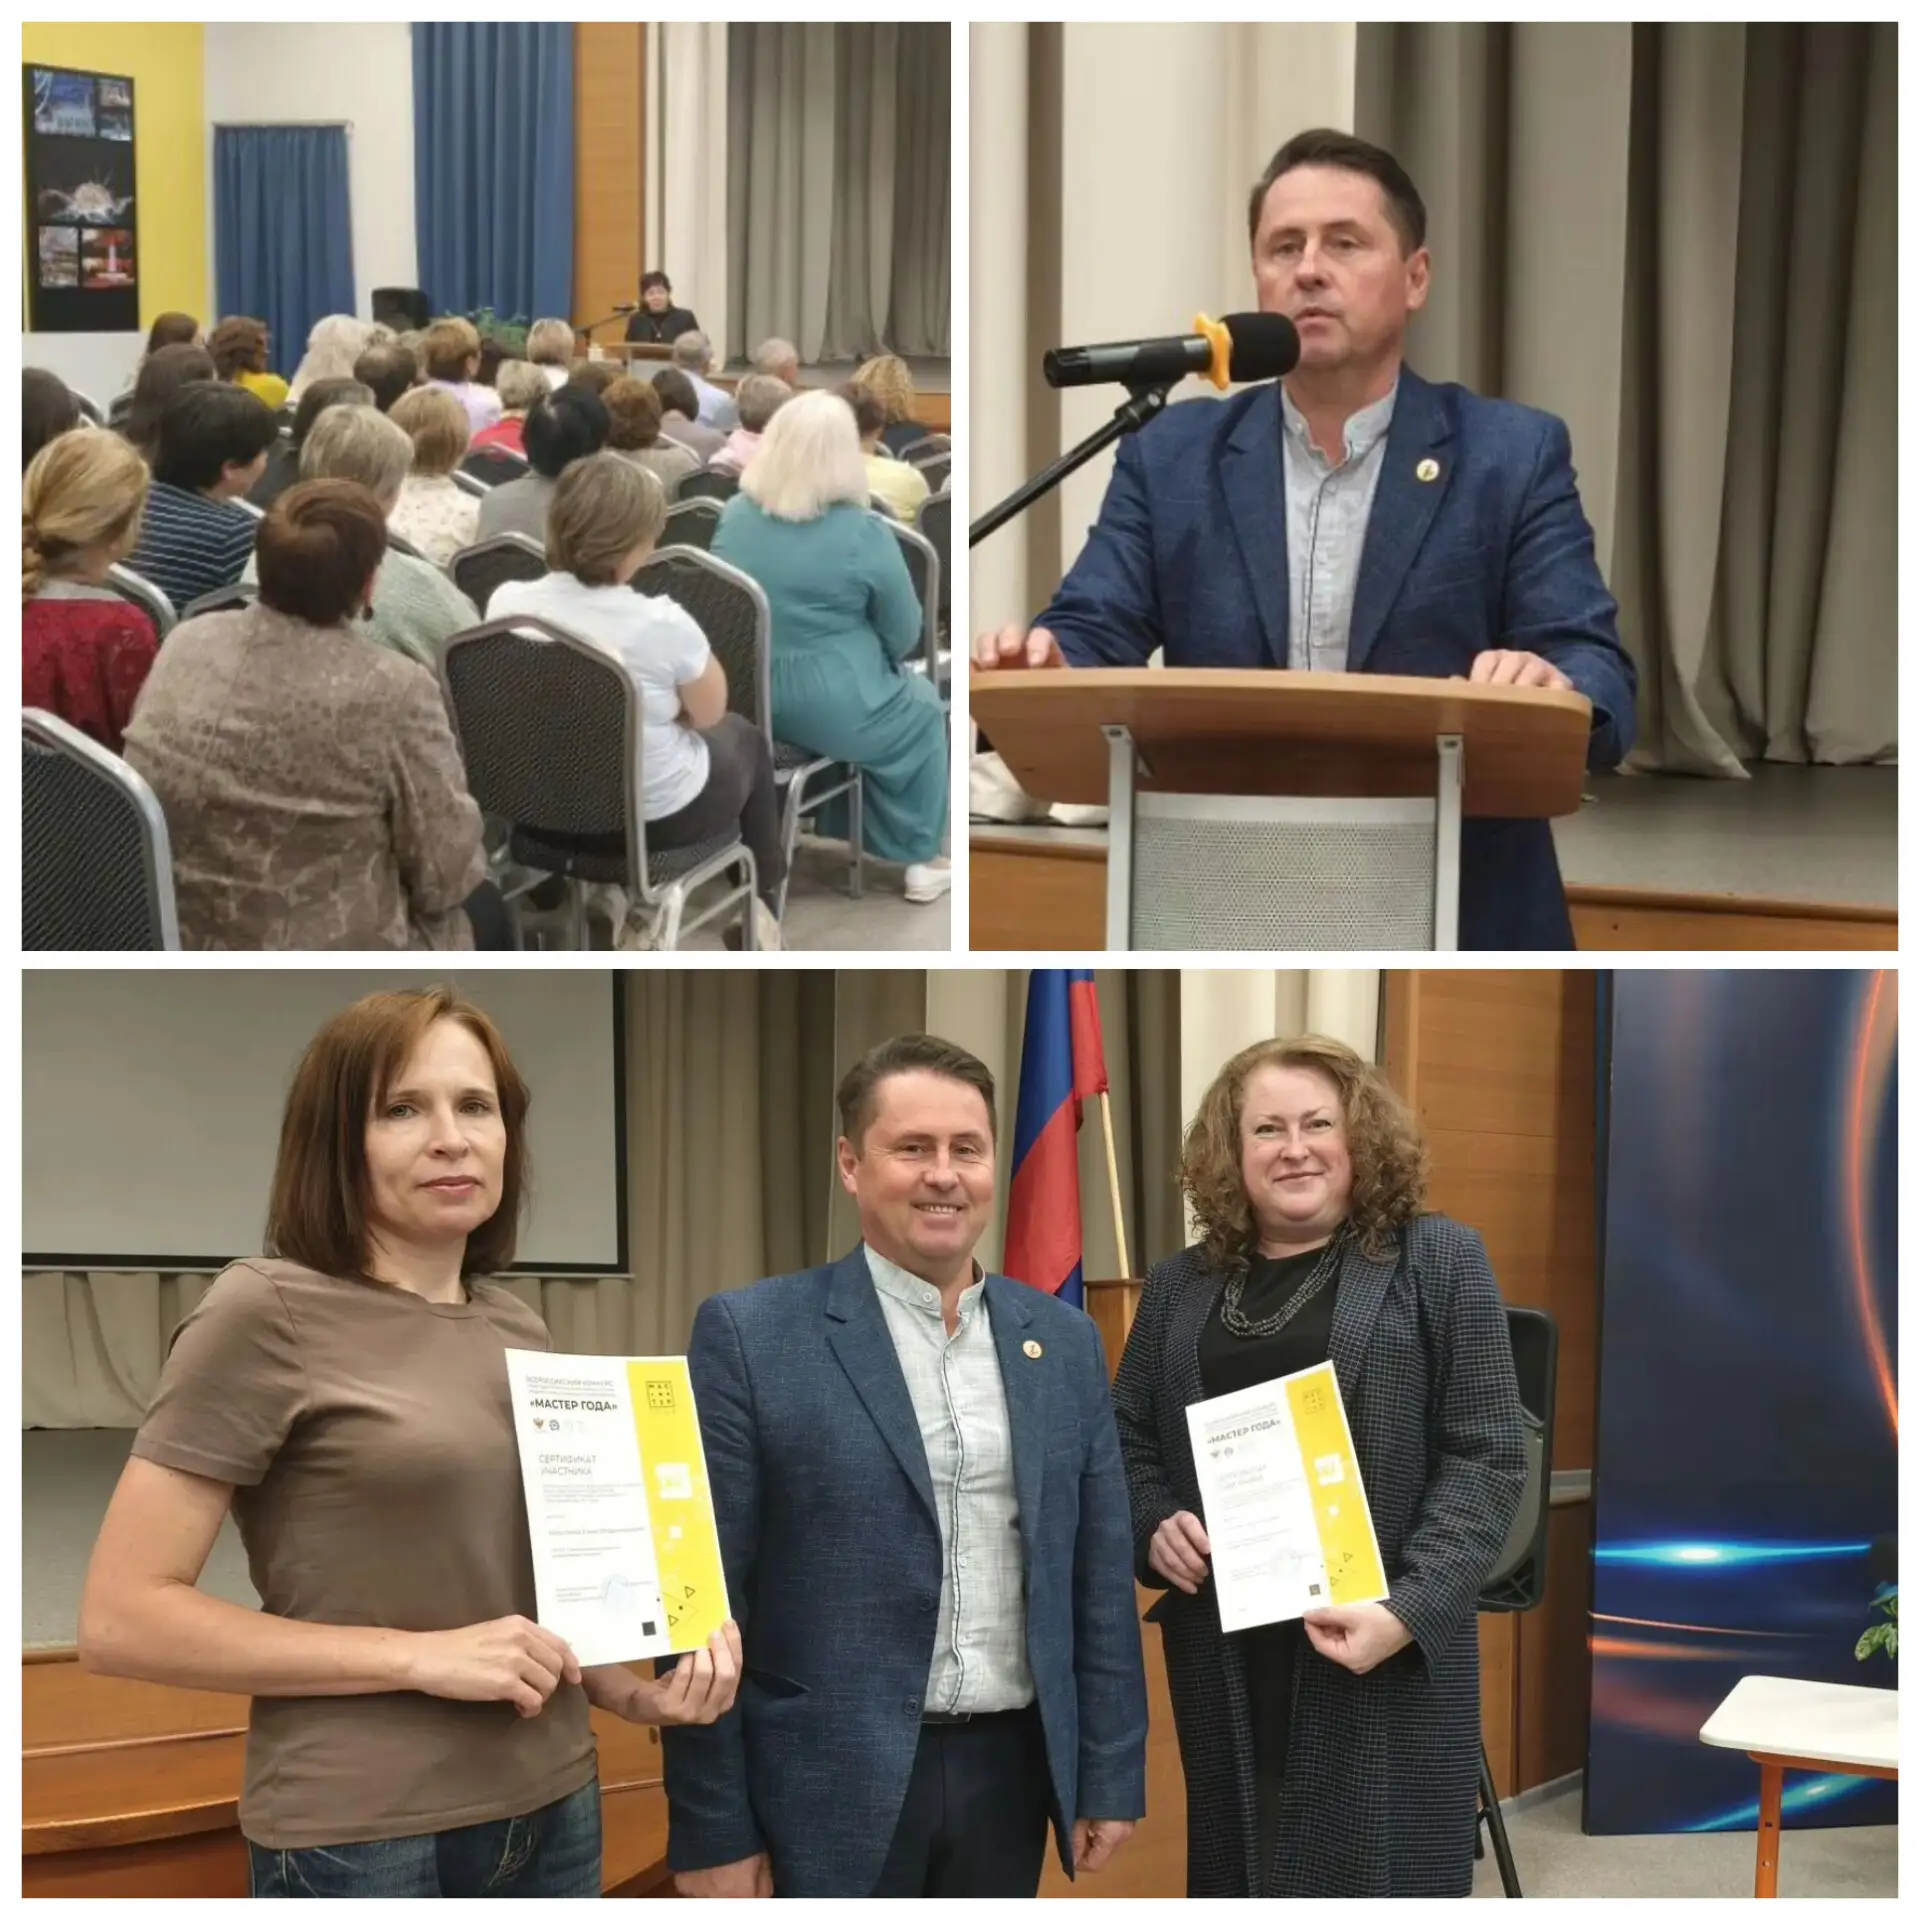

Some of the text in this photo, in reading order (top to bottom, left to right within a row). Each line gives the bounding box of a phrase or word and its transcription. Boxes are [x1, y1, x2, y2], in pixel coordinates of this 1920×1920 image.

[530, 1397, 618, 1412] «МАСТЕР ГОДА»
[1207, 1419, 1281, 1445] «МАСТЕР ГОДА»
[539, 1454, 597, 1464] СЕРТИФИКАТ
[540, 1466, 593, 1477] УЧАСТНИКА
